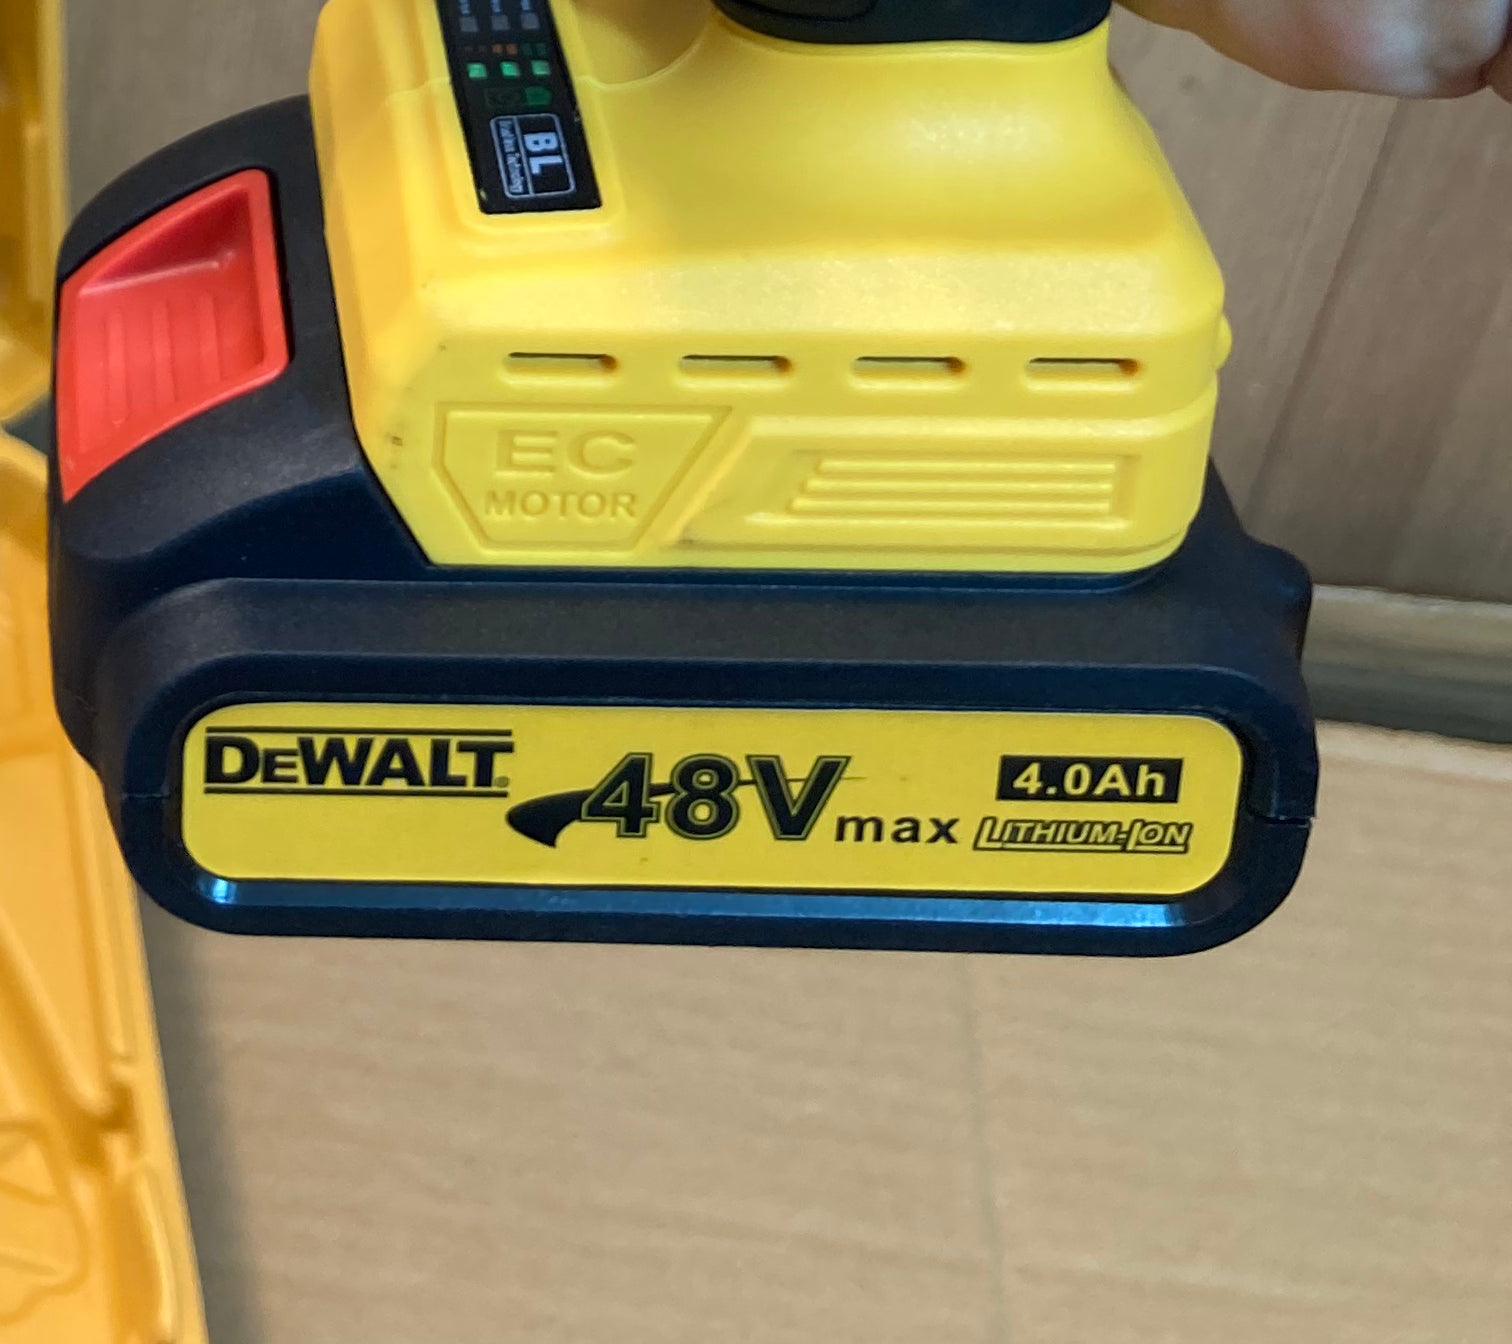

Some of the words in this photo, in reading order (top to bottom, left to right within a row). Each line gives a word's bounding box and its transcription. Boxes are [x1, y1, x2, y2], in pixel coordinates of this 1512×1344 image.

[523, 131, 564, 175] BL
[495, 429, 637, 477] EC
[485, 490, 638, 519] MOTOR
[204, 735, 514, 788] DEWALT
[1012, 761, 1166, 797] 4.0Ah
[581, 752, 852, 841] 48V
[834, 815, 960, 844] max
